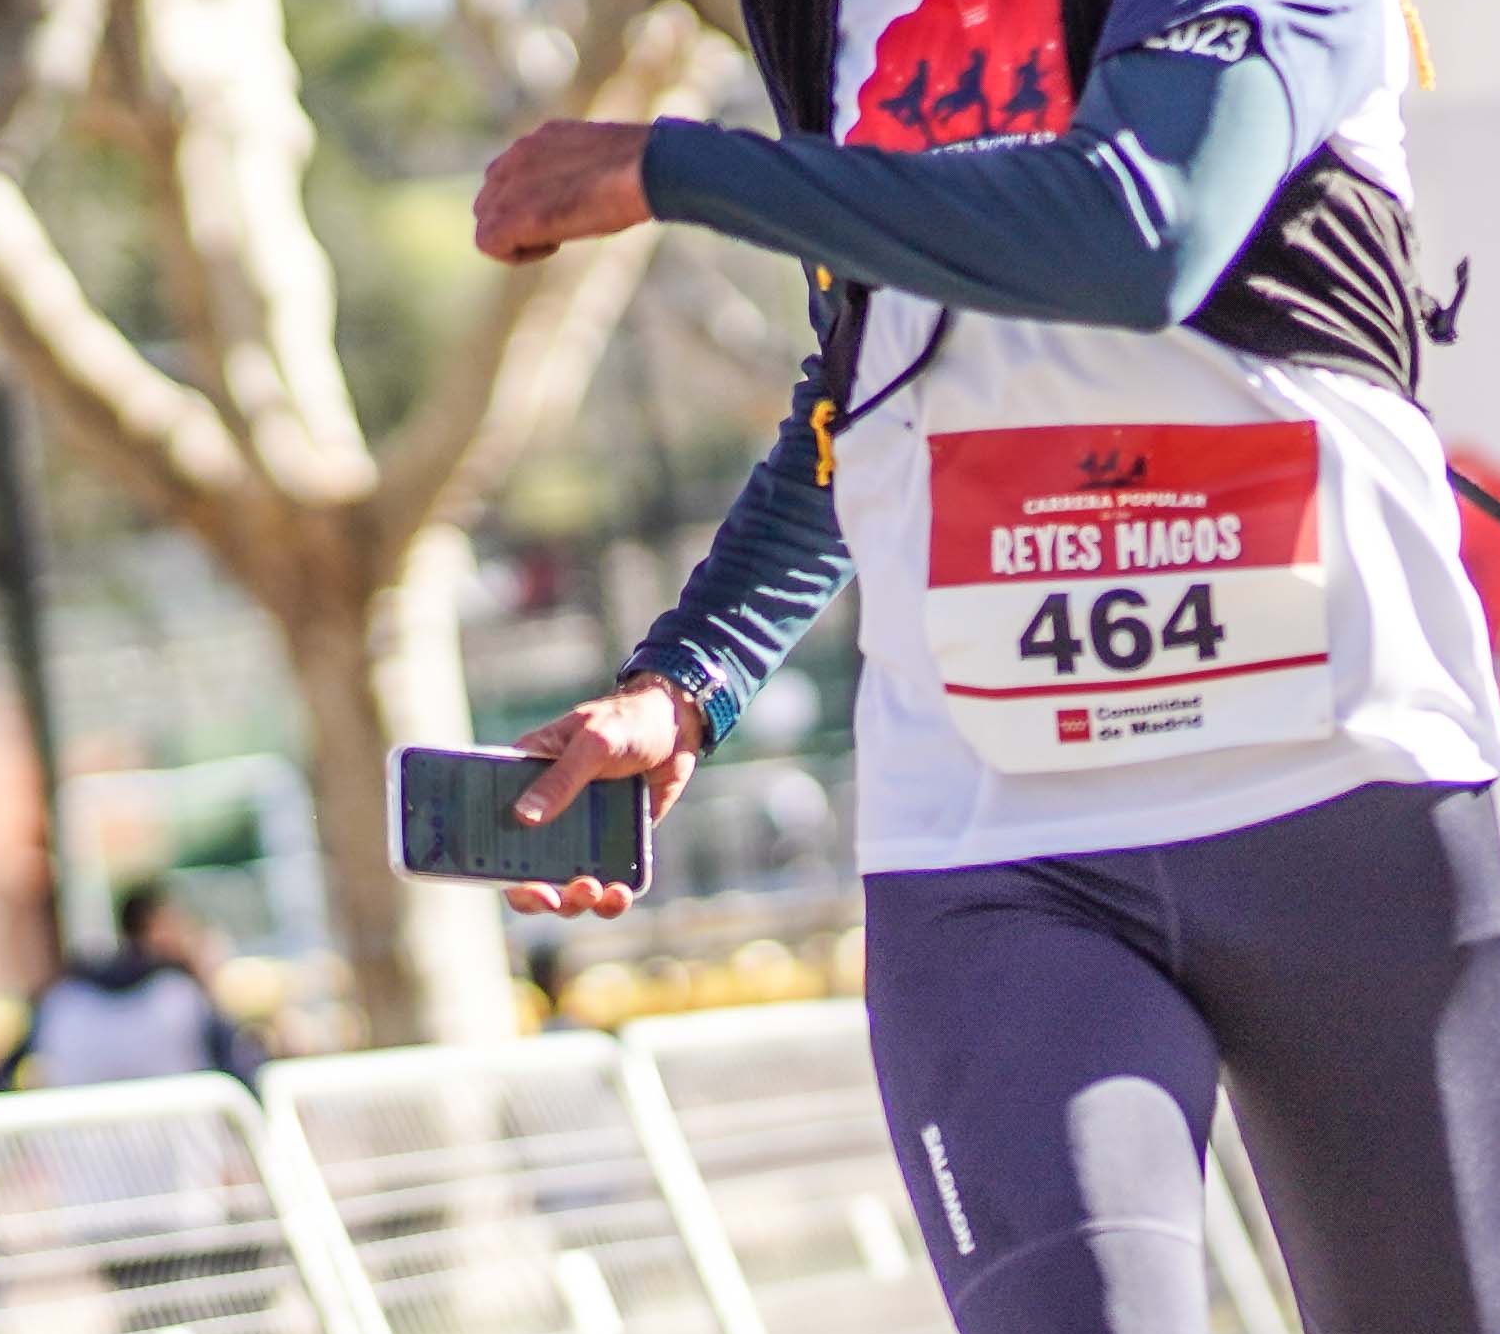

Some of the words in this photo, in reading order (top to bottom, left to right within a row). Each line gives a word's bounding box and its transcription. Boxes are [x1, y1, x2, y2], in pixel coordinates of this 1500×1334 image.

[990, 523, 1102, 575] REYES
[1114, 513, 1241, 570] MAGOS
[1020, 583, 1224, 675] 464
[1096, 694, 1203, 719] Comunidad
[1129, 715, 1203, 735] Madrid
